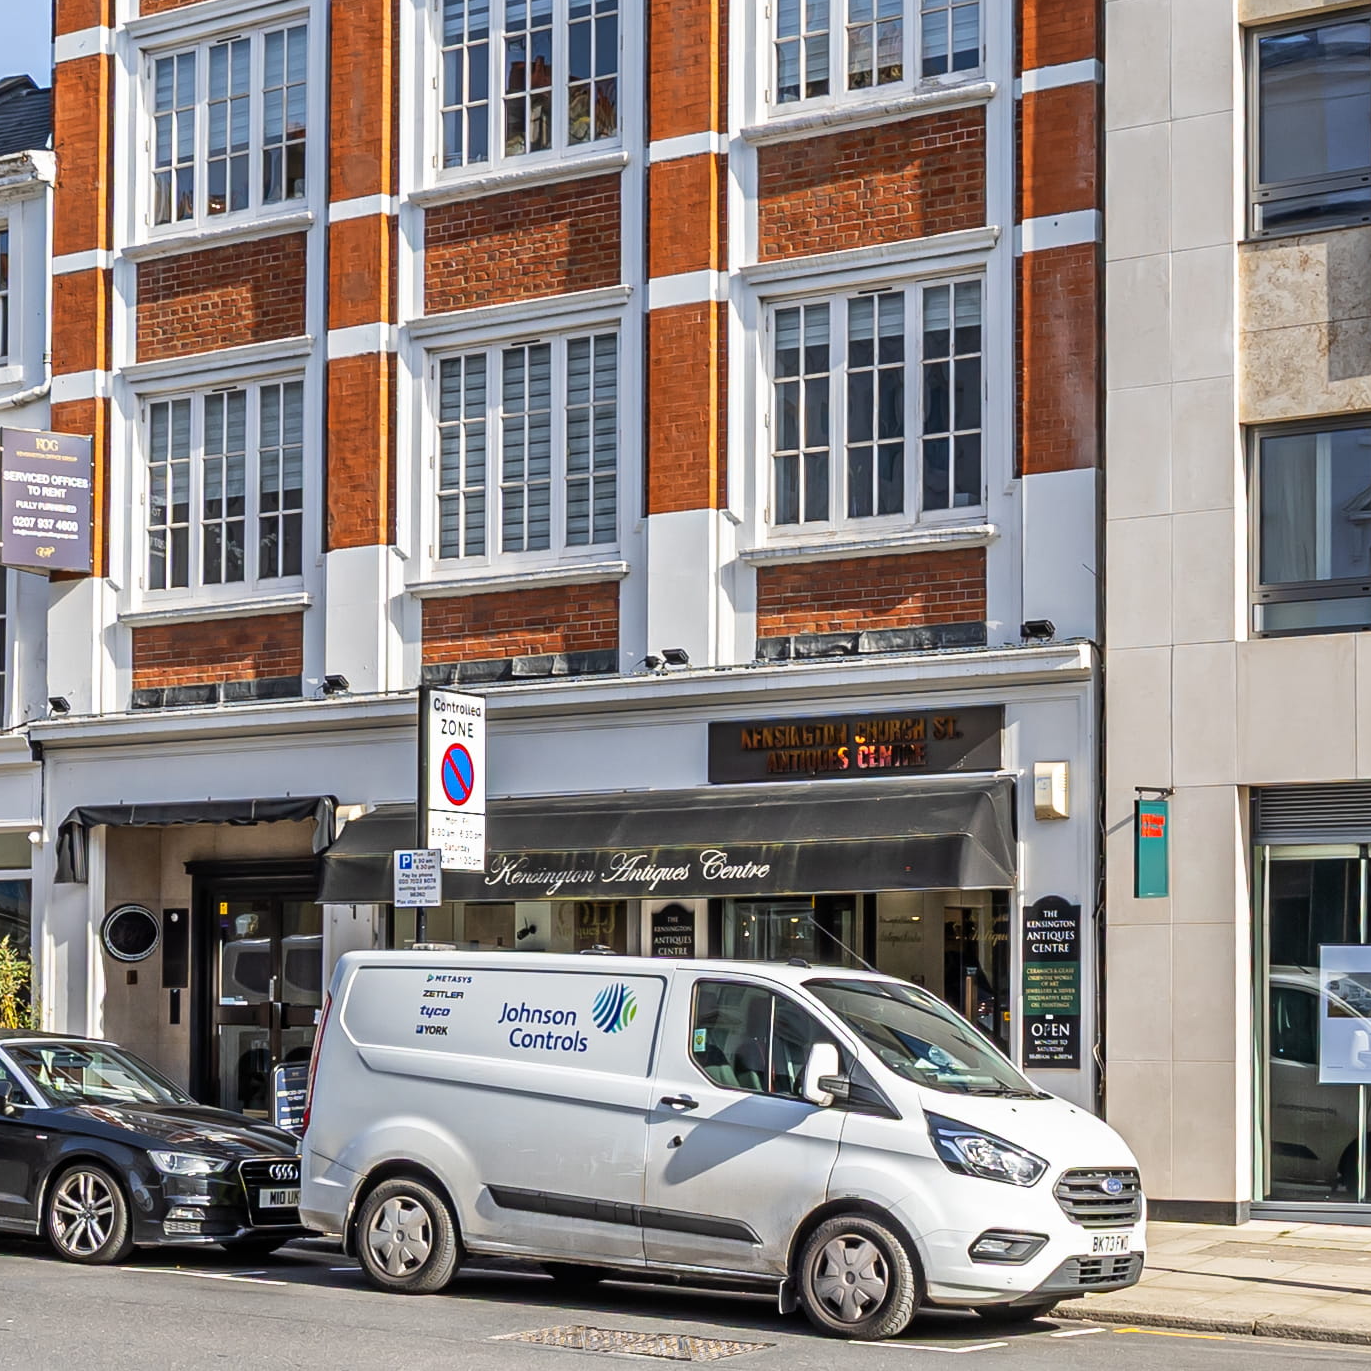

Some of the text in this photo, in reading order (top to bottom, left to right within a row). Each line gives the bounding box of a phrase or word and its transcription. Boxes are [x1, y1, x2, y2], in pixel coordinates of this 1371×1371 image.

[3, 471, 88, 488] SERVICED OFFICES
[28, 485, 67, 498] TO RENT
[434, 698, 481, 717] Controlled
[441, 719, 474, 738] ZONE
[854, 717, 925, 743] CHURCH
[766, 746, 850, 773] ANTIQUES
[403, 855, 410, 868] P
[601, 852, 690, 891] Antiques
[700, 849, 771, 880] Centre
[1027, 920, 1075, 928] KENSINGTON
[654, 936, 692, 946] ANTIQUES
[1027, 931, 1075, 941] ANTIQUES
[658, 947, 688, 956] CENTRE
[1032, 943, 1069, 953] CENTRE
[435, 975, 472, 984] METASYS
[422, 990, 464, 999] ZETTLER
[419, 1005, 450, 1018] tyco
[498, 1002, 577, 1026] Johnson
[423, 1025, 448, 1036] YORK
[1031, 1023, 1070, 1036] OPEN
[509, 1028, 588, 1052] Controls
